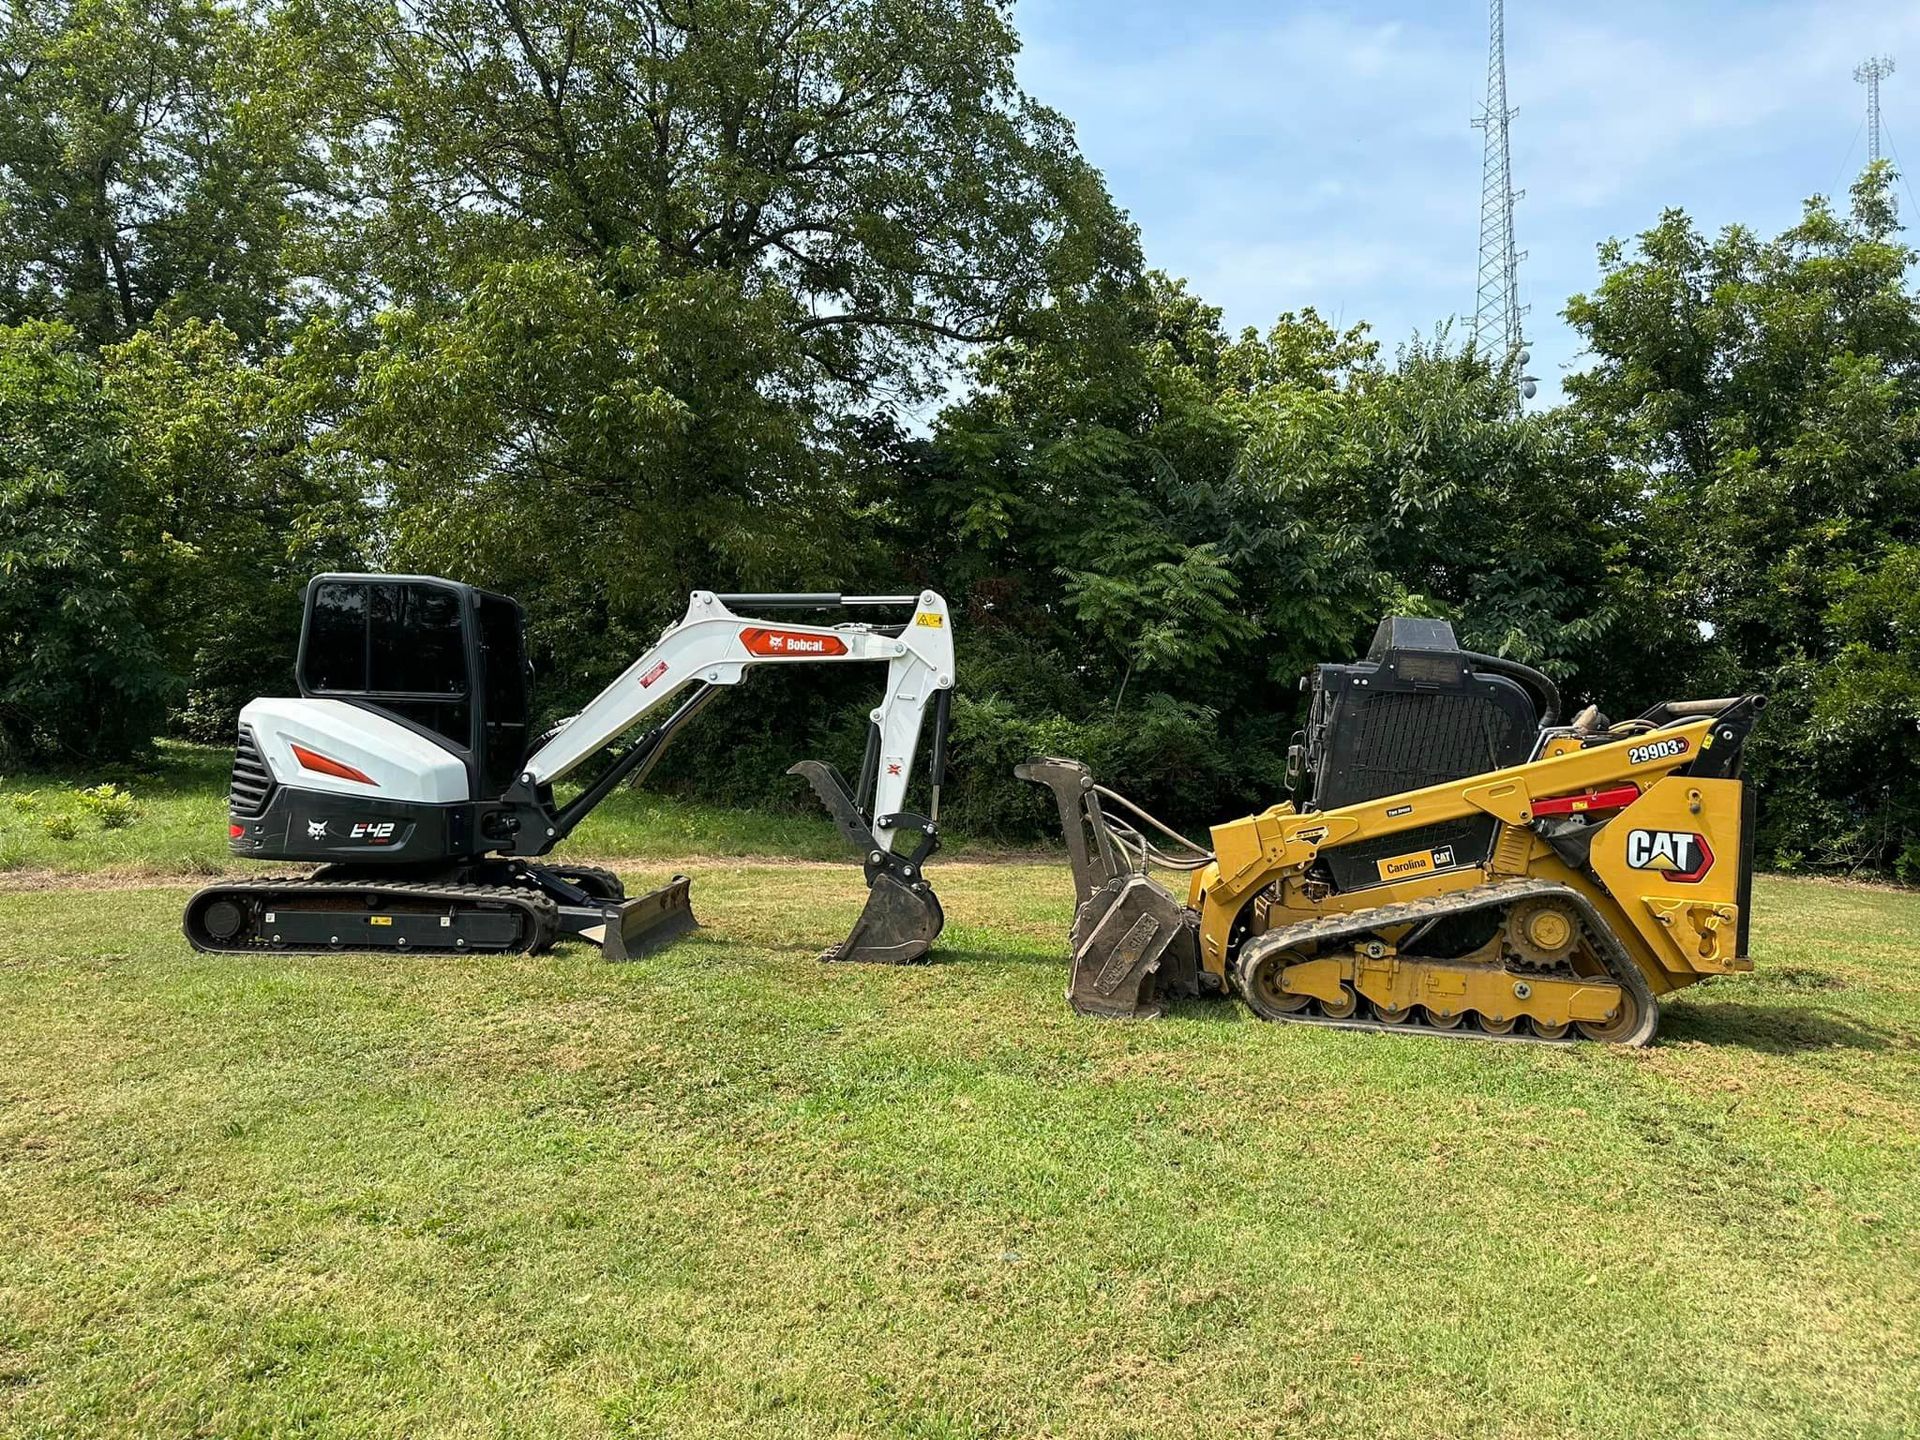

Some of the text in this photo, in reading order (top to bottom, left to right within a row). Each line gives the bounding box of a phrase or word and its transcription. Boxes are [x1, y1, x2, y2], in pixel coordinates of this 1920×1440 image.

[787, 638, 823, 651] Bobcat
[1629, 739, 1680, 764] 299D3
[350, 823, 395, 838] E42
[1628, 830, 1694, 871] CAT
[1387, 851, 1450, 873] Carolina CAT
